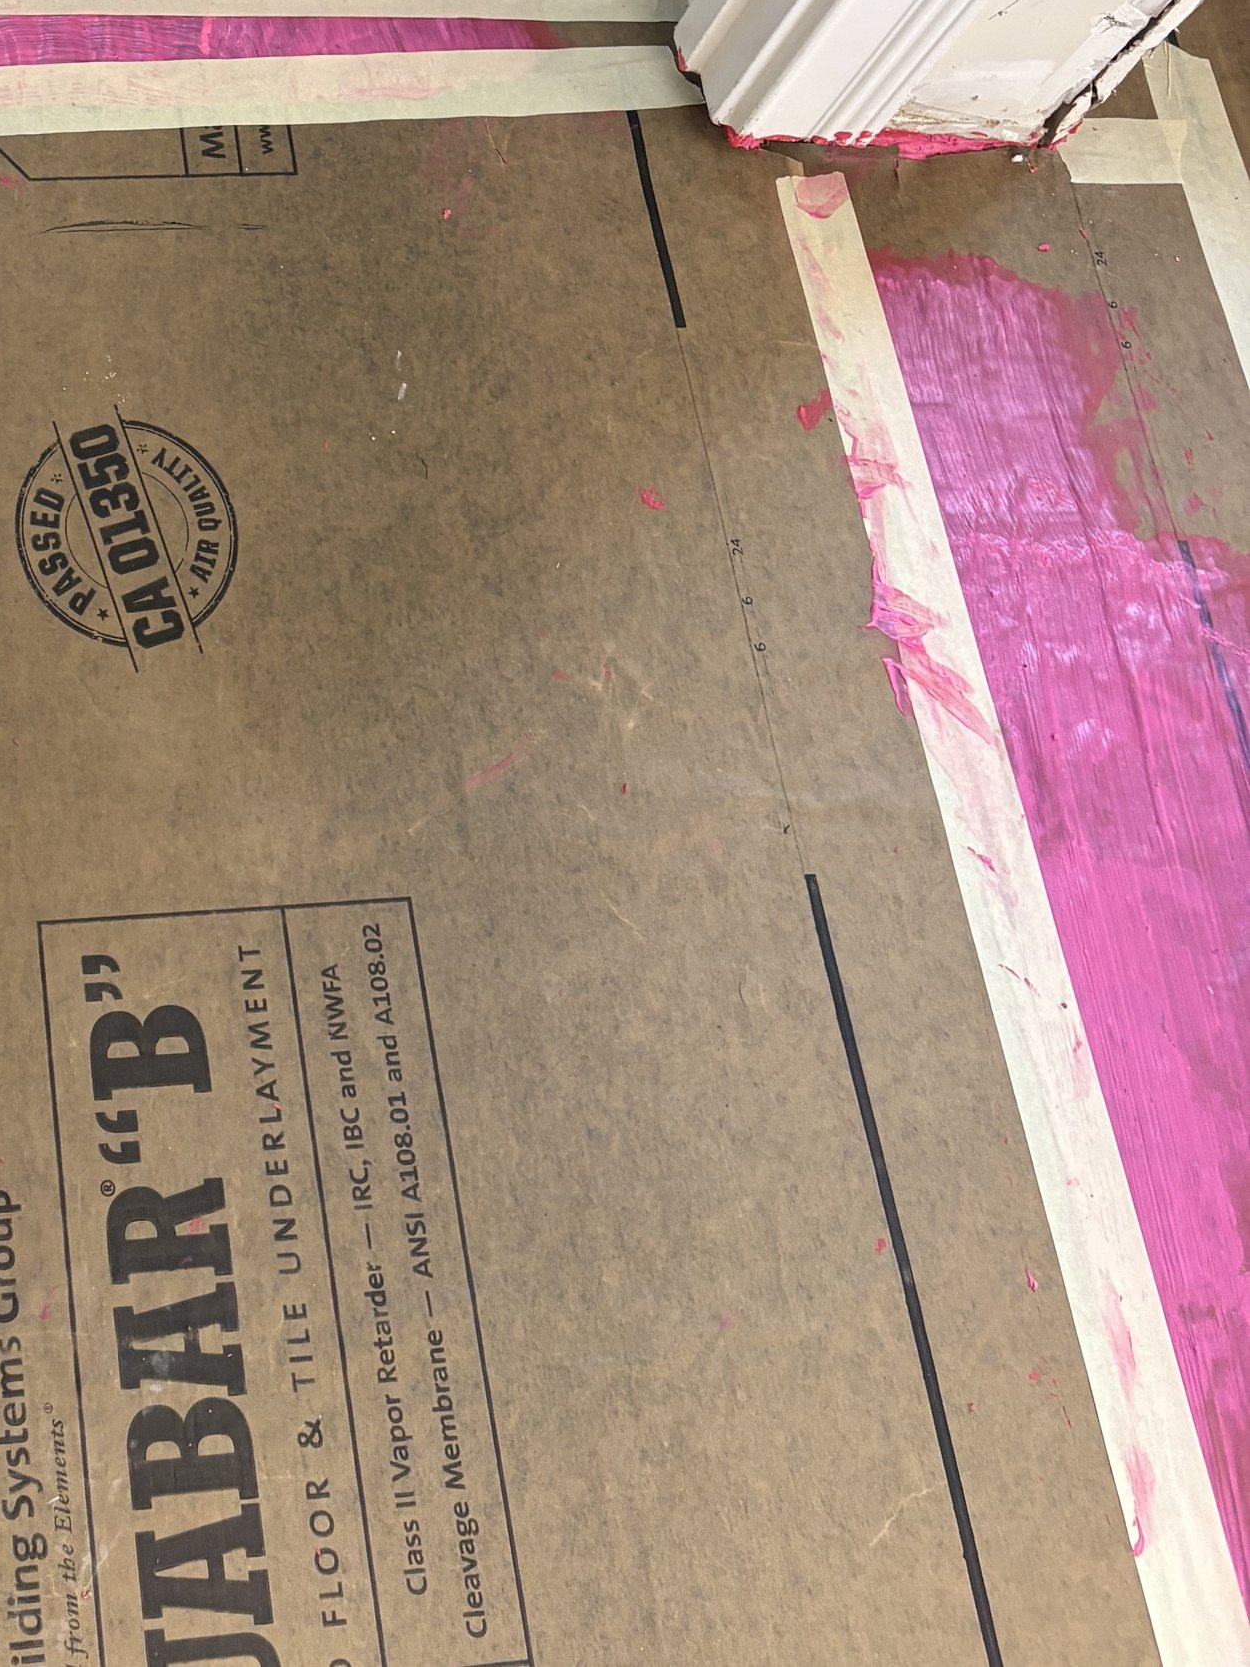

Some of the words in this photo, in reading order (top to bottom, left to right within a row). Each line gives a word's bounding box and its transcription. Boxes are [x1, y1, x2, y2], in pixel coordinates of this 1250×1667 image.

[1094, 251, 1107, 266] 24
[1107, 300, 1118, 309] 6
[1121, 340, 1132, 349] 6
[68, 423, 160, 575] 01350
[150, 447, 223, 532] QUALITY
[30, 487, 96, 616] PASSED
[189, 538, 220, 584] AIR
[730, 538, 744, 556] 24
[121, 576, 185, 649] CA
[742, 596, 753, 605] 6
[754, 642, 766, 652] 6
[321, 963, 349, 1041] NWFA
[362, 923, 394, 1026] A108.02
[81, 954, 212, 1165] “B”
[330, 1051, 357, 1098] and
[376, 1036, 403, 1082] and
[238, 945, 301, 1274] UNDERLAYMENT
[340, 1107, 364, 1150] IBC
[387, 1091, 423, 1202] A108.01
[349, 1159, 373, 1210] IRC,
[405, 1212, 434, 1279] ANSI
[283, 1303, 315, 1392] TILE
[364, 1262, 398, 1383] Retarder
[297, 1418, 323, 1448] &
[386, 1394, 413, 1482] Vapor
[428, 1329, 466, 1490] Membrane
[394, 1491, 416, 1508] II
[58, 1543, 78, 1583] the
[305, 1477, 347, 1628] FLOOR
[403, 1519, 428, 1595] Class
[454, 1501, 488, 1638] Cleavage
[64, 1592, 89, 1660] from
